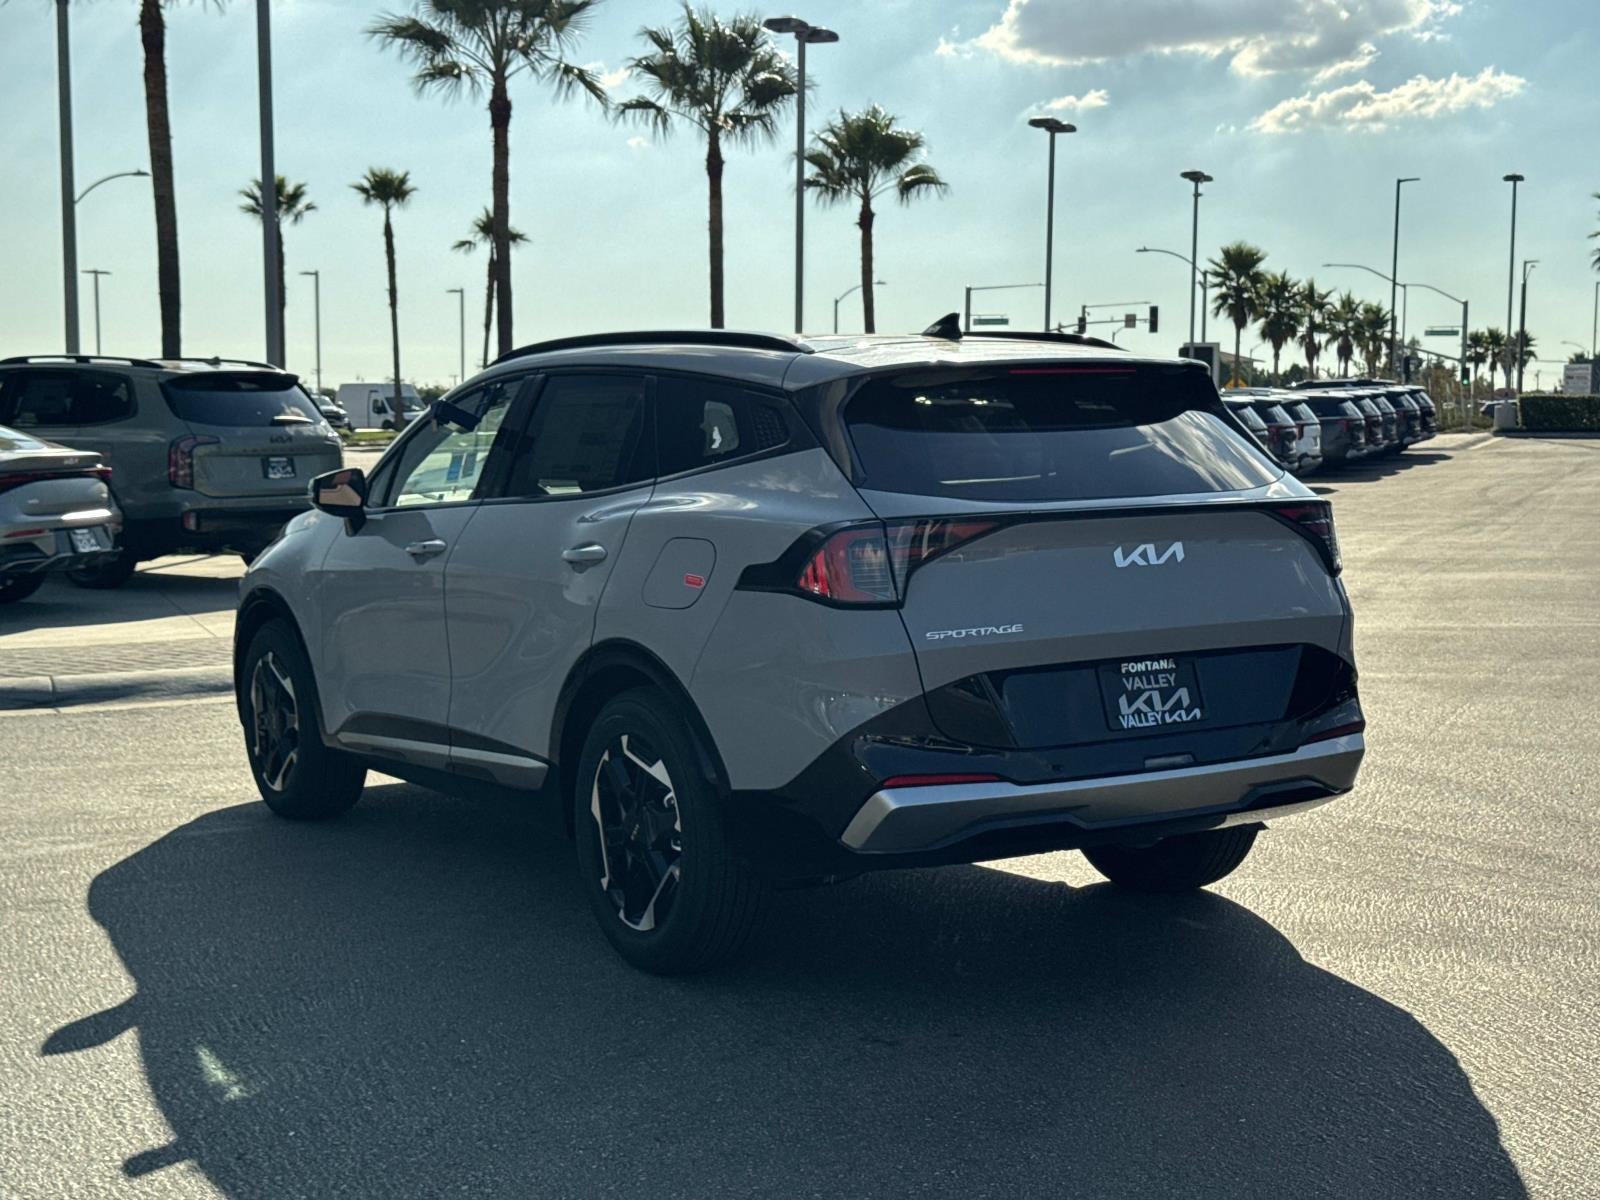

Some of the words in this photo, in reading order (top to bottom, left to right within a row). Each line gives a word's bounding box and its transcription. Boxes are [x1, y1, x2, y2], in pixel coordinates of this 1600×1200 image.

[1113, 541, 1185, 568] KIA
[925, 624, 1024, 640] SPORTAGE
[1121, 658, 1176, 674] FONTANA
[1122, 673, 1176, 691] VALLEY
[1118, 687, 1190, 715] KIA
[1118, 711, 1162, 729] VALLEY
[1164, 707, 1201, 724] KIA
